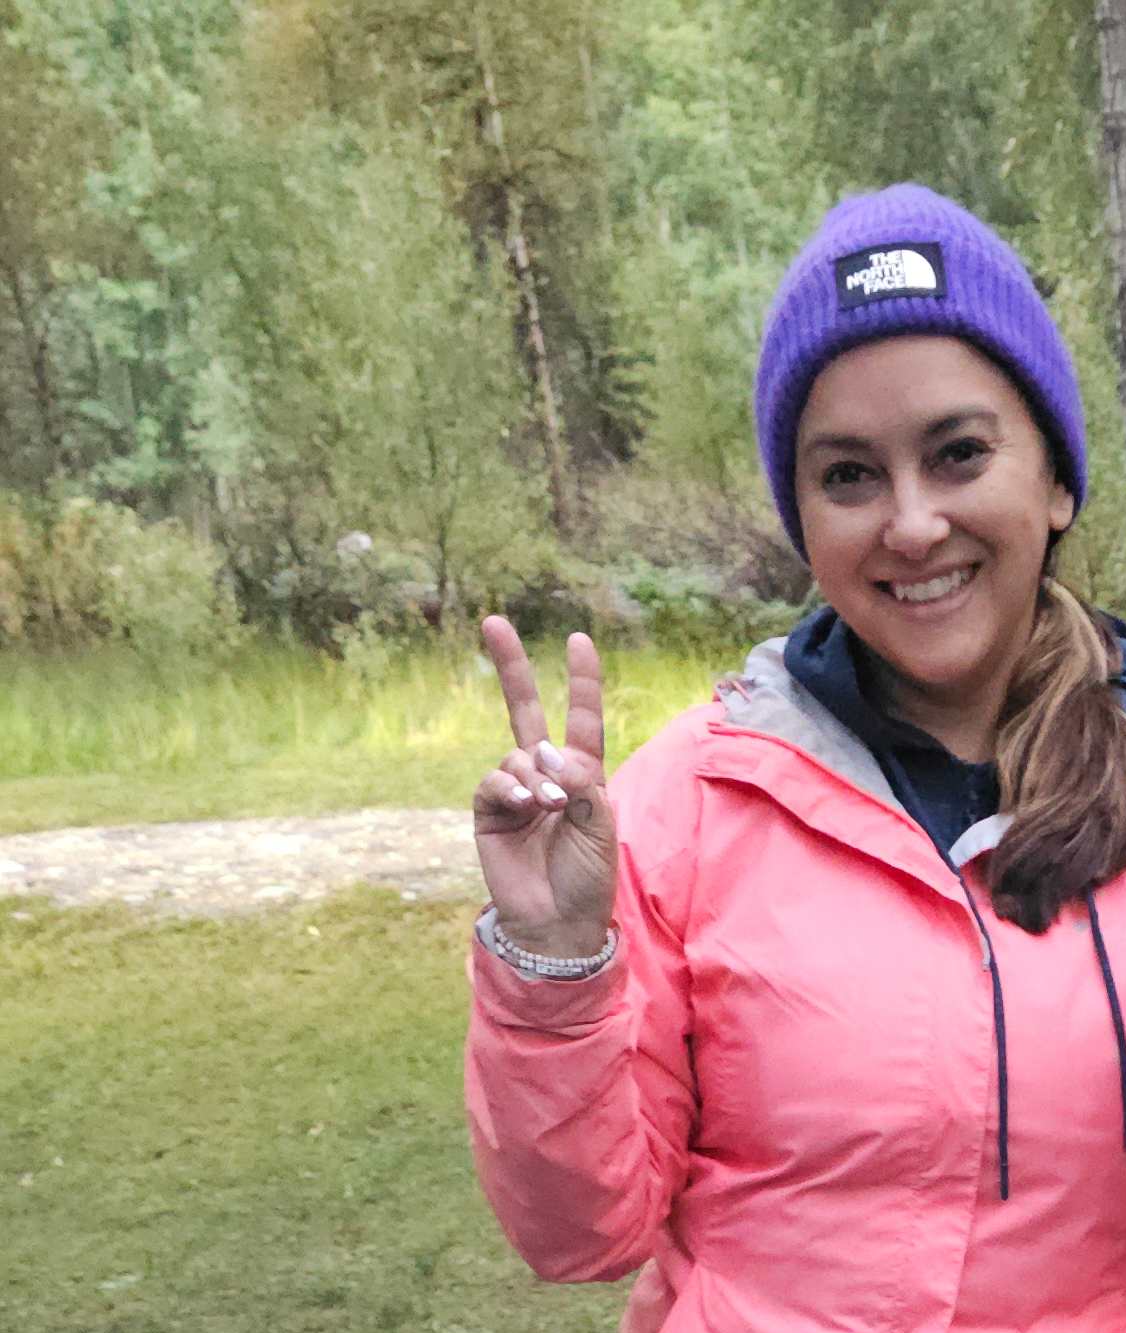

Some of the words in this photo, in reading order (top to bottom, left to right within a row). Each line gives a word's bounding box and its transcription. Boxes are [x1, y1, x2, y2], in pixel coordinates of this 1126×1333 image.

[869, 251, 903, 267] THE
[846, 264, 904, 290] NORTH
[864, 276, 906, 295] FACE
